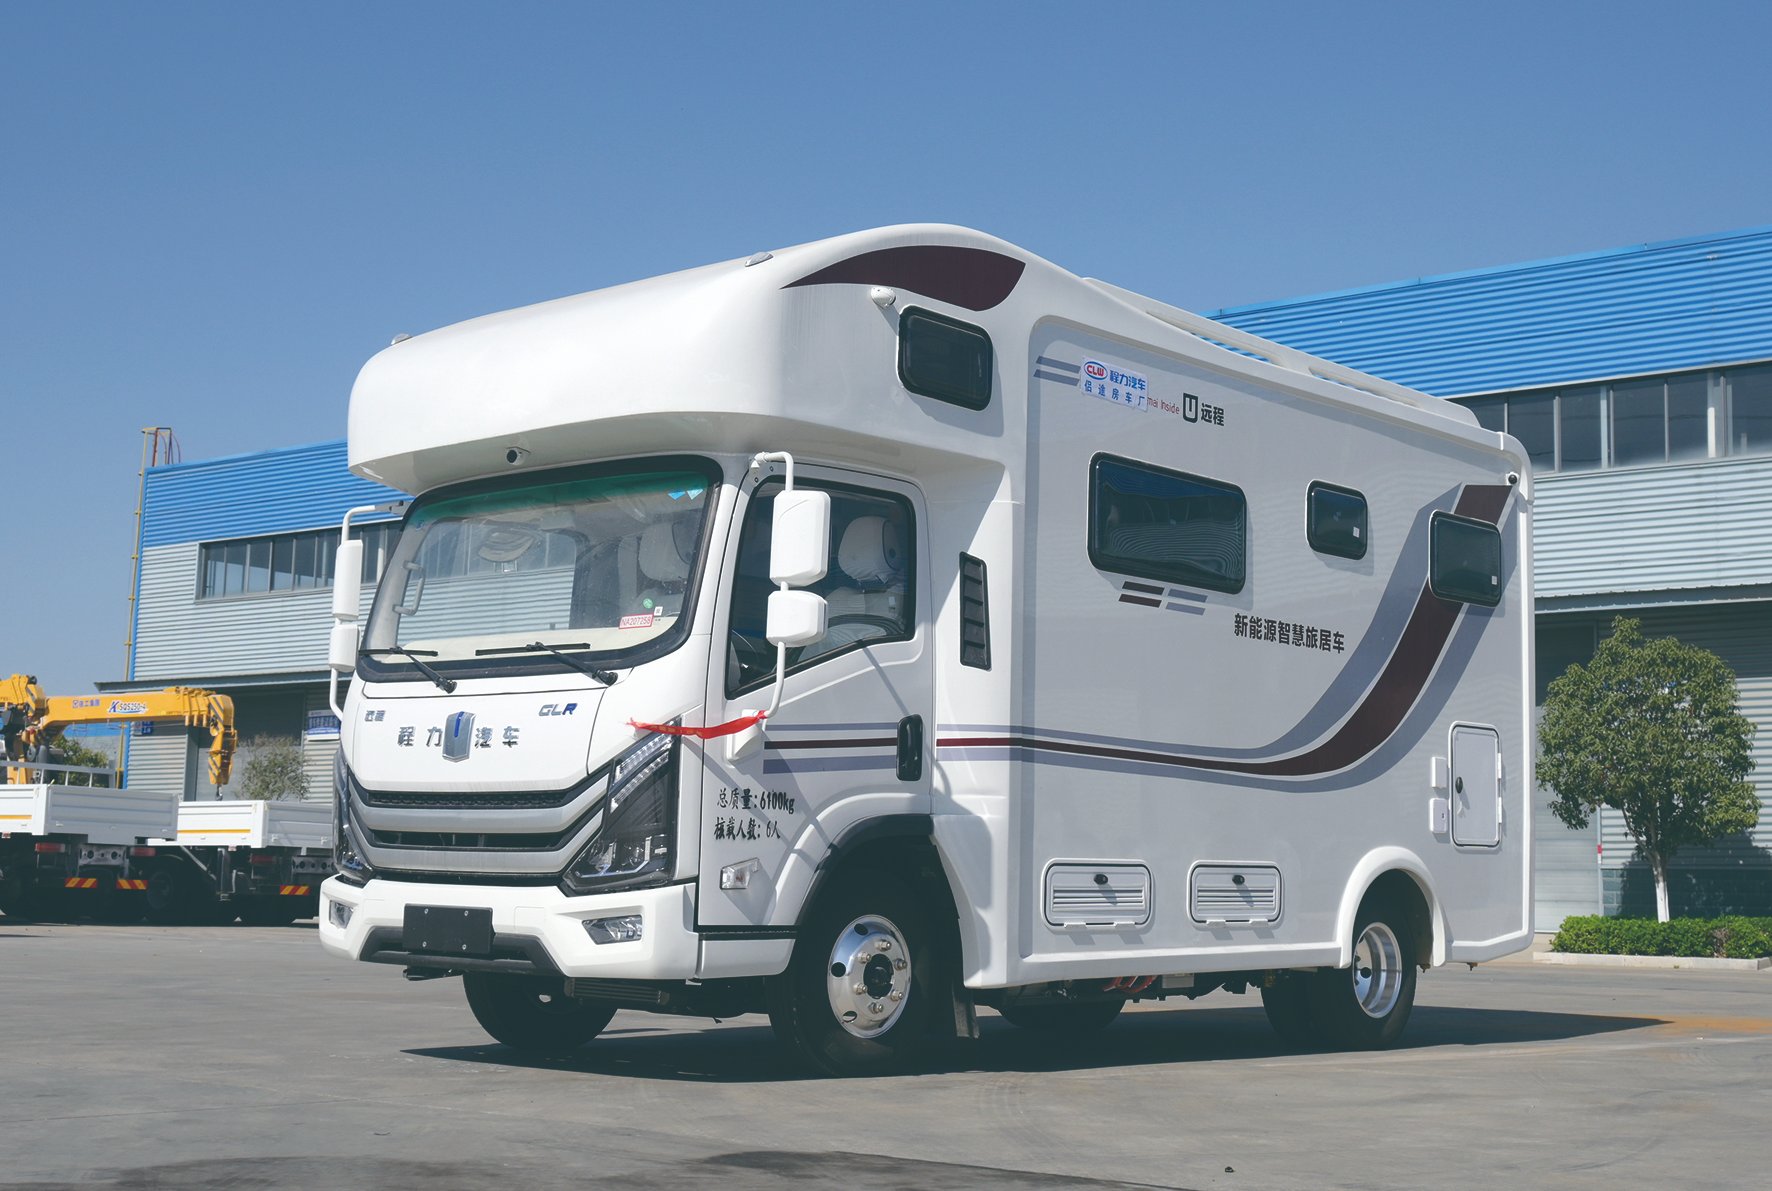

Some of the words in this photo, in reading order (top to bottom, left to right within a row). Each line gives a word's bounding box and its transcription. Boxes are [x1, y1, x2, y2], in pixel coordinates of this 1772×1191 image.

[1087, 365, 1105, 377] CLW
[1110, 370, 1146, 391] 程力汽车
[1201, 403, 1224, 426] 远程
[1234, 613, 1345, 654] 新能源智慧旅居车
[539, 703, 578, 716] GLR
